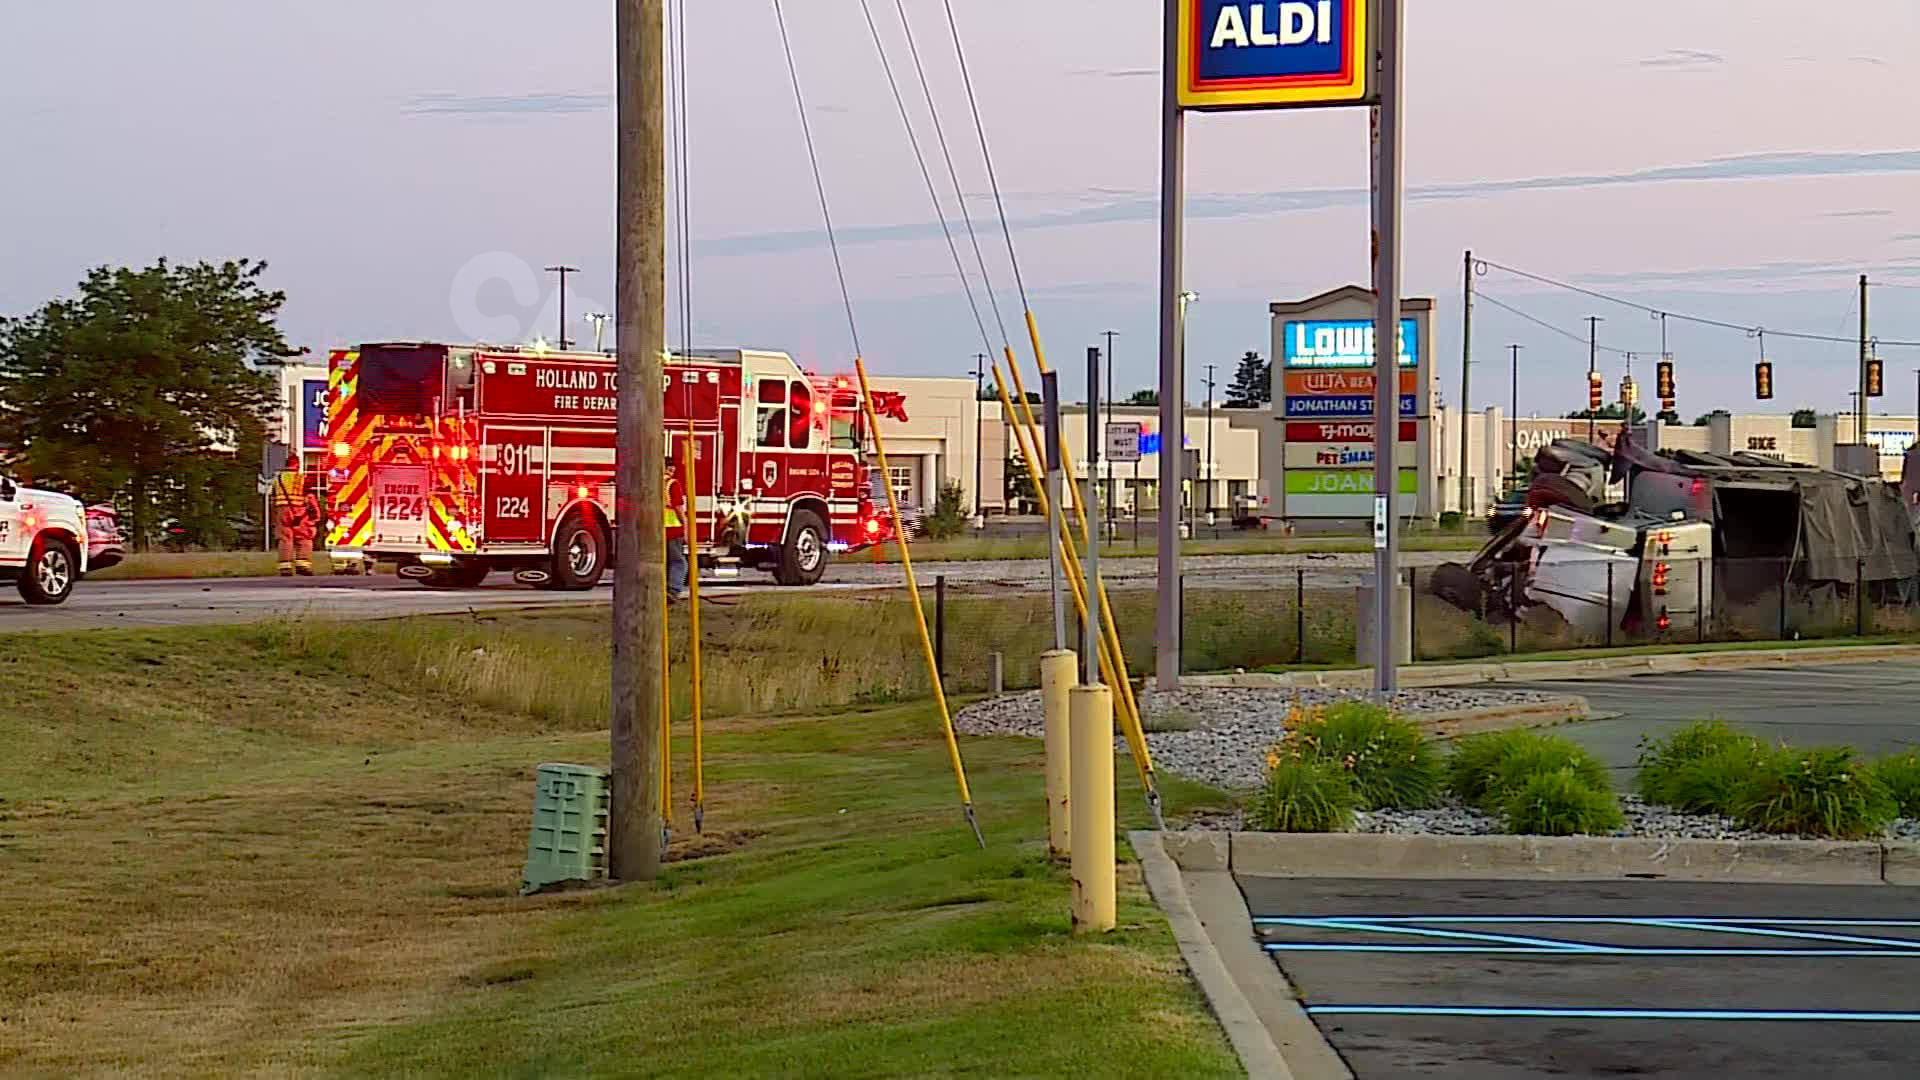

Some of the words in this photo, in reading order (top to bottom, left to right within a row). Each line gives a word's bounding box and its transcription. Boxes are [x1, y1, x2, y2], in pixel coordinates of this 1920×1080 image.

[1210, 1, 1332, 48] ALDI
[536, 369, 598, 390] HOLLAND
[1305, 373, 1346, 391] ULTA
[1350, 377, 1375, 388] BEA
[554, 395, 579, 409] FIRE
[583, 396, 617, 410] DEPAR
[1290, 399, 1357, 412] JONATHAN
[1360, 399, 1412, 411] STNS
[504, 443, 531, 476] 911
[1316, 451, 1375, 464] PETSMAR
[384, 483, 419, 495] ENGINE
[1308, 474, 1376, 491] JOAN
[379, 496, 423, 521] 1224
[496, 496, 530, 518] 1224
